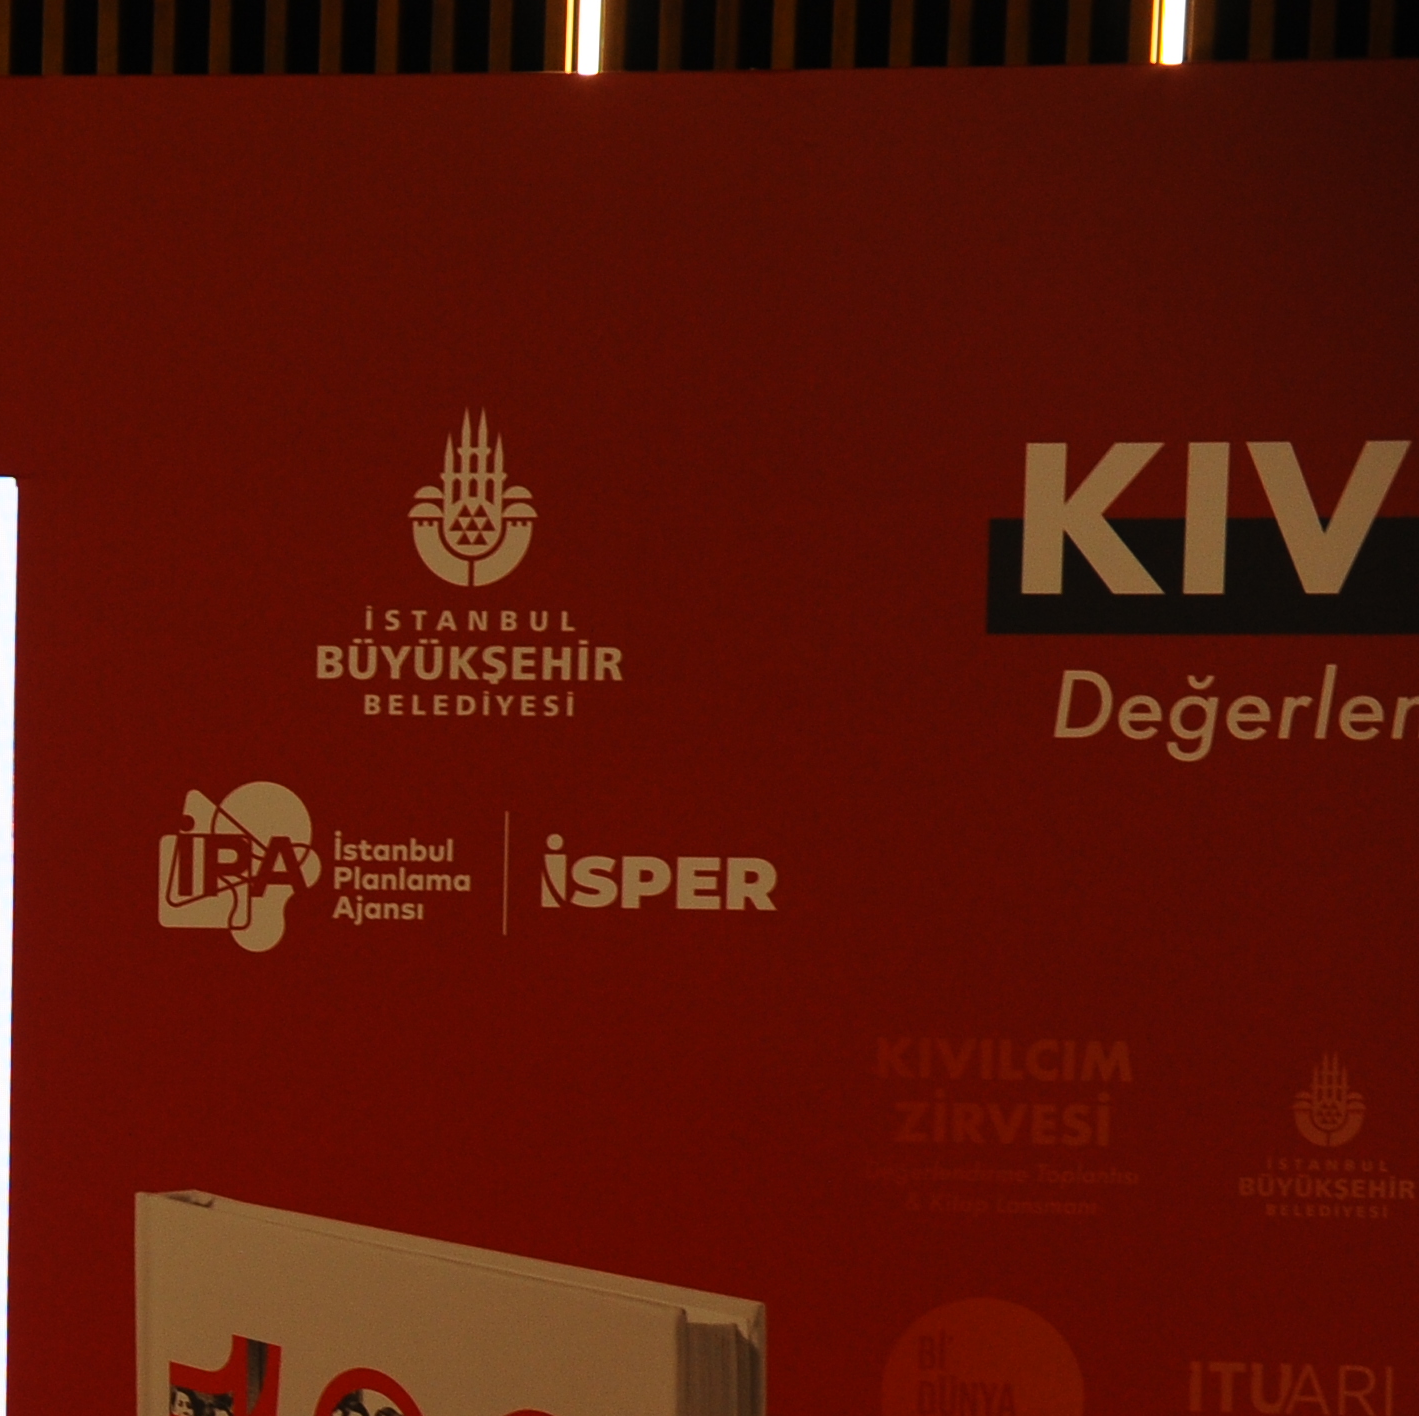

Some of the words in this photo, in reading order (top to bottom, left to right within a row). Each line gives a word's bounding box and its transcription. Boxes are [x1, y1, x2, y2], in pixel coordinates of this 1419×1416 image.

[365, 605, 576, 632] İSTANBUL
[316, 638, 623, 684] BÜYÜKŞEHİR
[363, 691, 575, 717] BELEDİYESİ
[333, 830, 454, 862] İstanbul
[333, 866, 472, 892] Planlama
[541, 833, 778, 911] İSPER
[332, 896, 424, 921] Ajansı
[875, 1036, 1133, 1082] KIVILCIM
[893, 1088, 1111, 1147] ZİRVESİ
[1266, 1155, 1389, 1173] İSTANBUL
[1237, 1172, 1416, 1200] BÜYÜKŞEHİR
[1265, 1203, 1389, 1219] BELEDİYESİ
